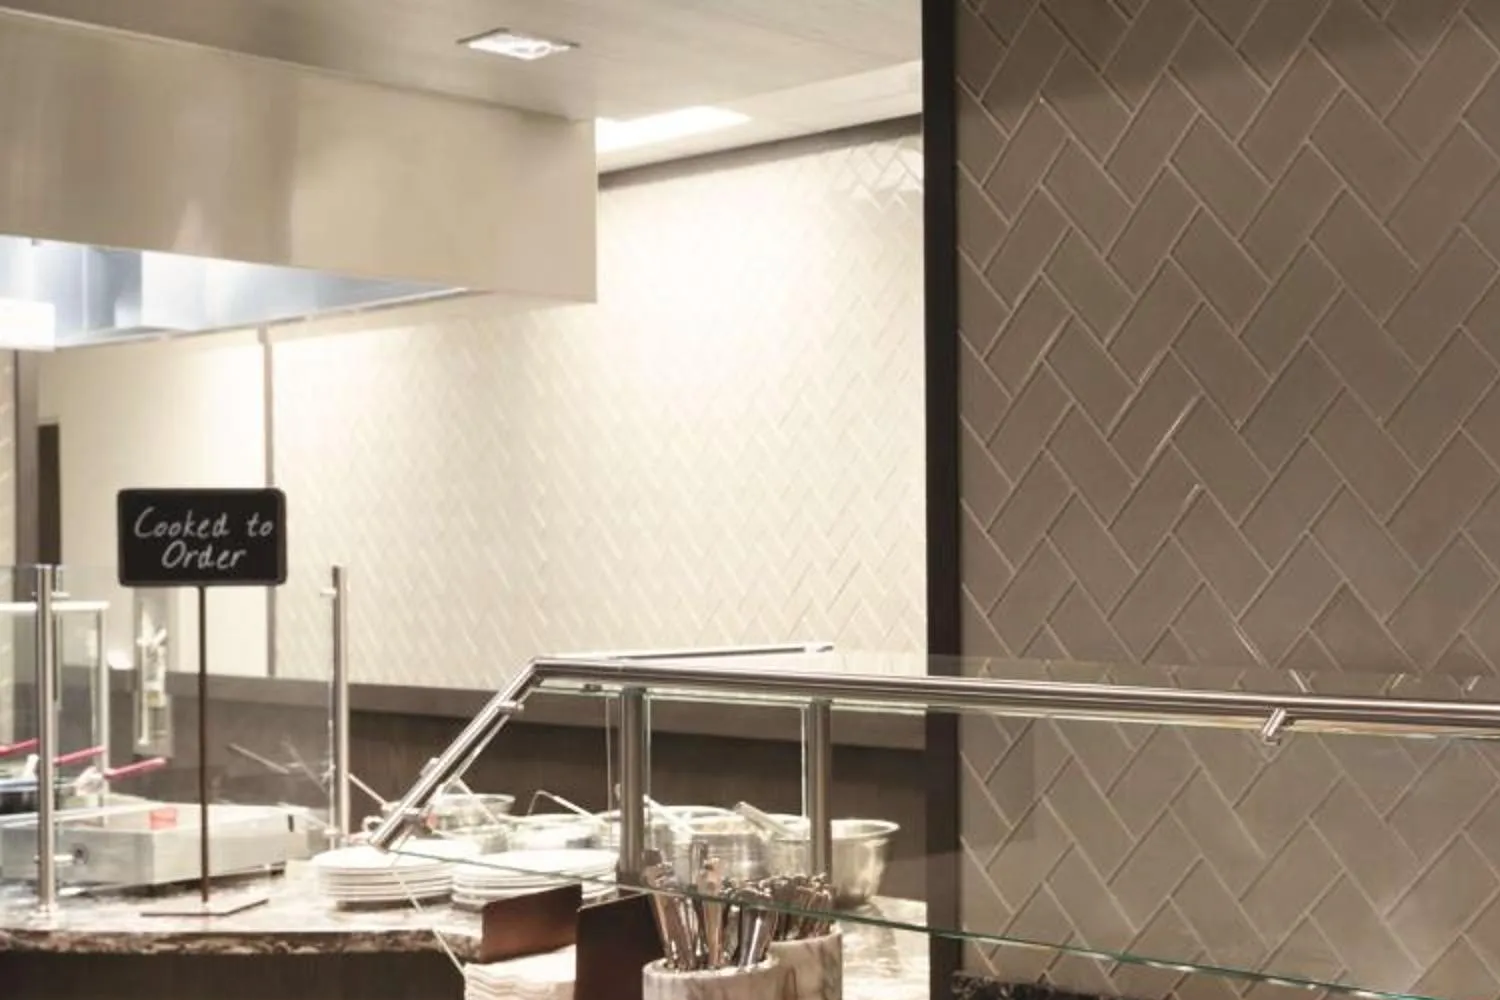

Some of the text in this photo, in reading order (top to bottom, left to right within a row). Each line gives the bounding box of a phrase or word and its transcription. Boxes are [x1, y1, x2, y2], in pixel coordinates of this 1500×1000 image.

[134, 506, 274, 538] Cooked to
[161, 540, 247, 569] Order
